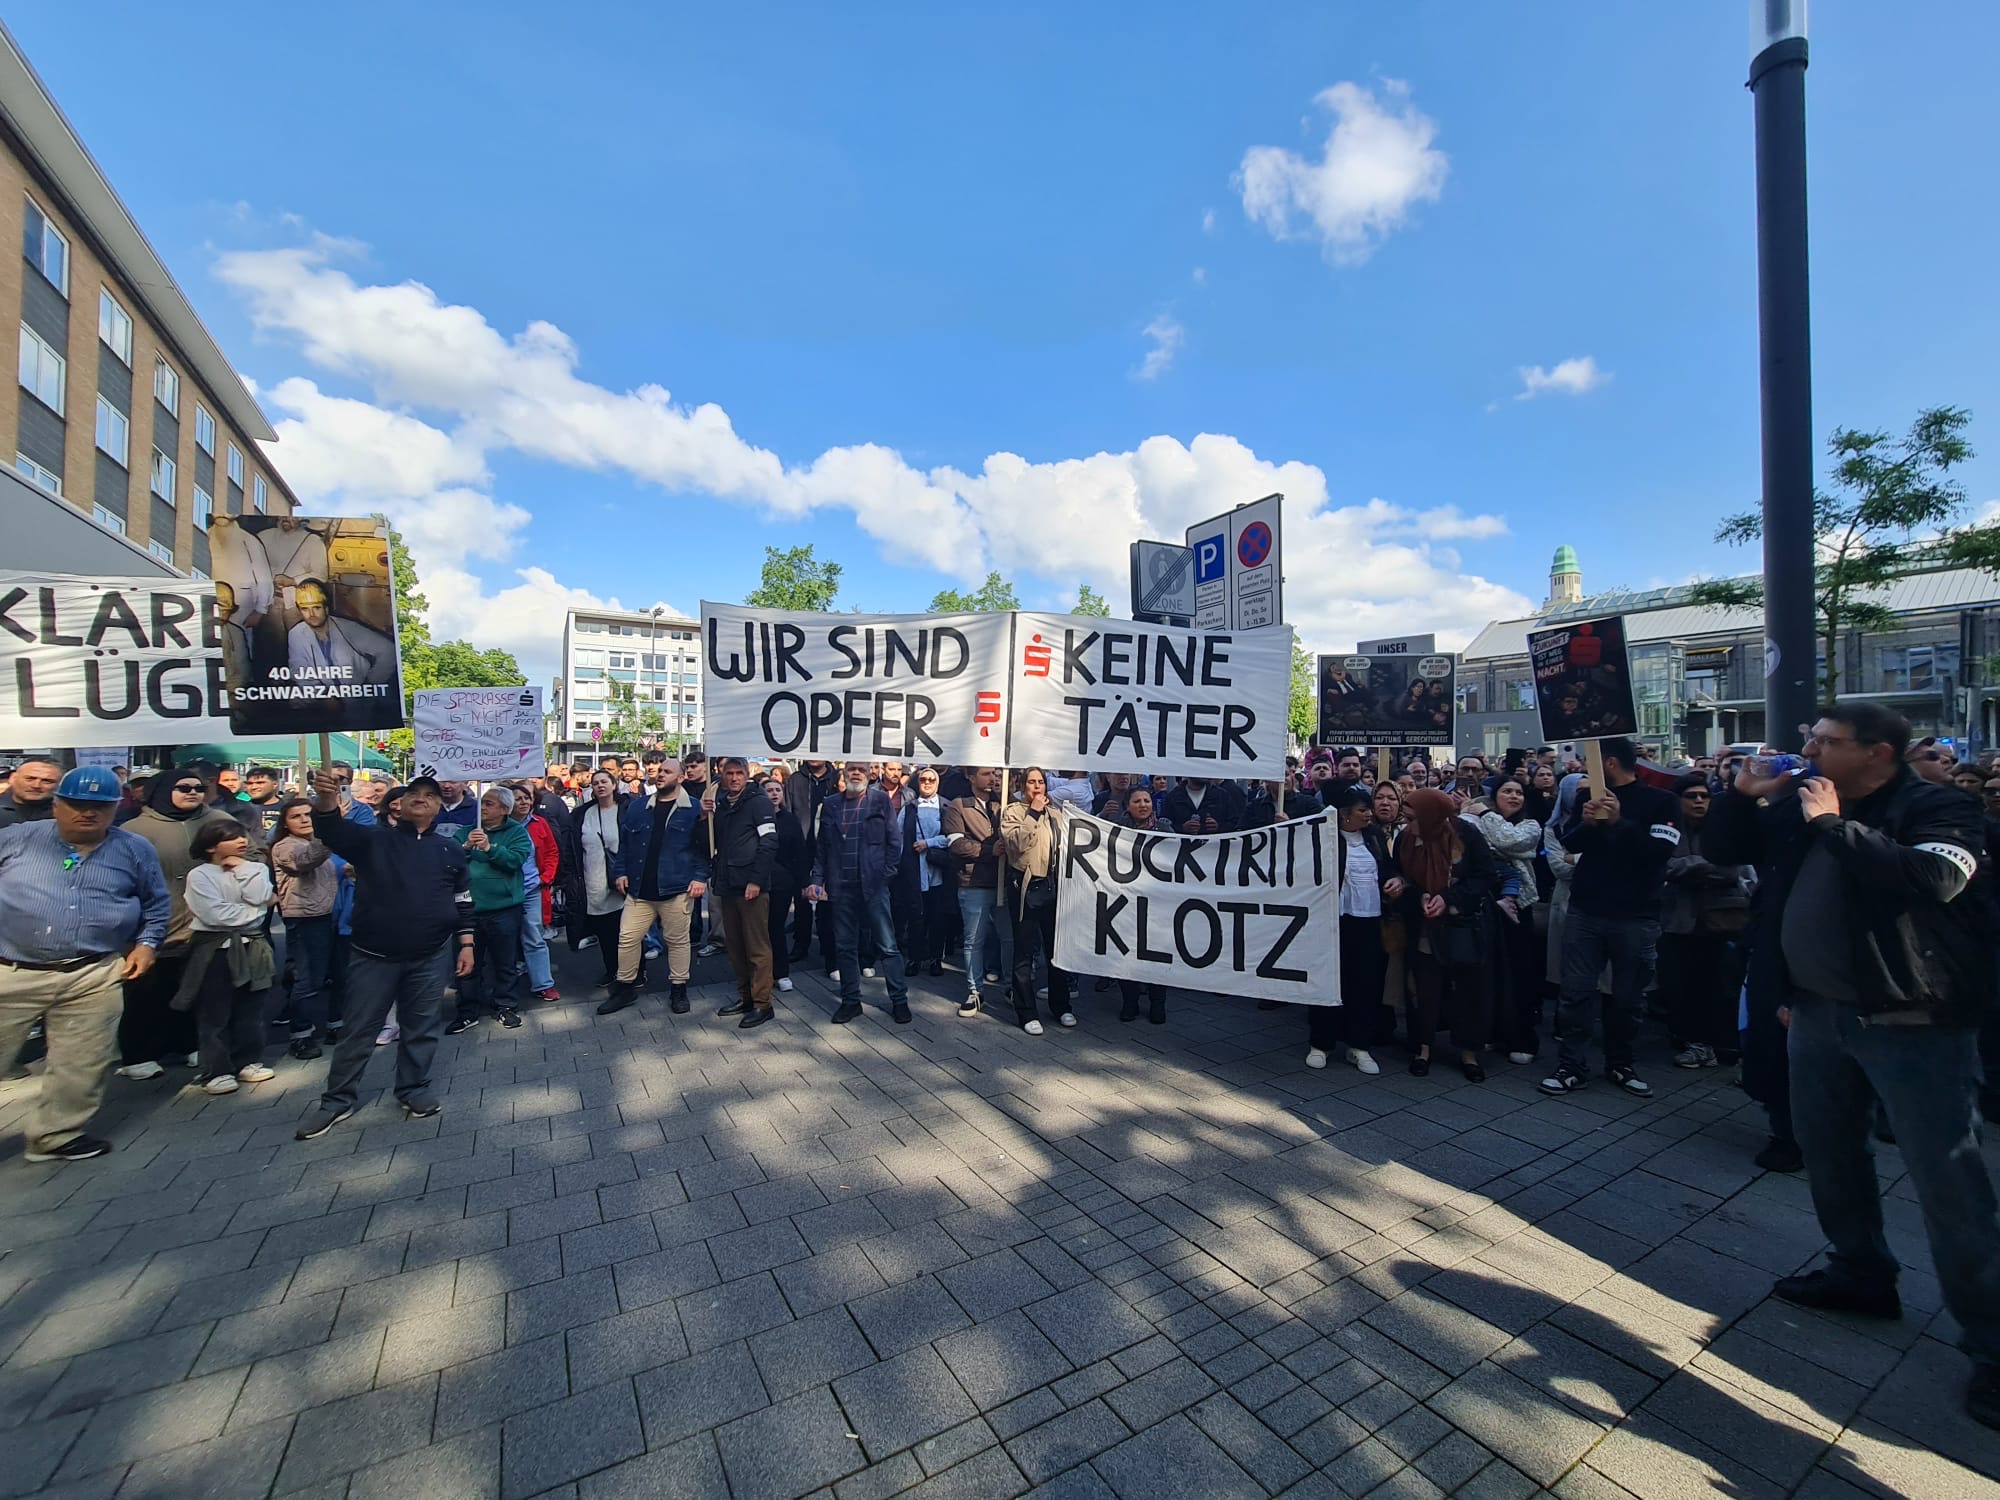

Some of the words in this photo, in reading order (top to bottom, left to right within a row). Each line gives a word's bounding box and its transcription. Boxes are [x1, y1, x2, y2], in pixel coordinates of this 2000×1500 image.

[1201, 543, 1217, 578] P
[1155, 597, 1183, 611] ZONE
[708, 618, 812, 683] WIR
[828, 625, 970, 679] SIND
[1377, 642, 1408, 654] UNSER
[1064, 629, 1232, 687] KEINE
[268, 666, 291, 681] 40
[294, 665, 353, 680] JAHRE
[234, 684, 389, 700] SCHWARZARBEIT
[416, 693, 441, 709] DIE
[444, 691, 517, 710] SPARKASSE
[450, 712, 470, 724] IST
[471, 709, 513, 725] NICHT
[761, 691, 943, 758] OPFER
[421, 728, 462, 743] OPFER
[472, 727, 504, 739] SIND
[1064, 694, 1258, 762] TÄTER
[1372, 735, 1402, 743] HAFTUNG
[1405, 735, 1448, 743] GERECHTIGKEIT
[428, 745, 464, 763] 3000
[460, 758, 507, 772] BÜRGER
[1094, 891, 1309, 983] KLOTZ
